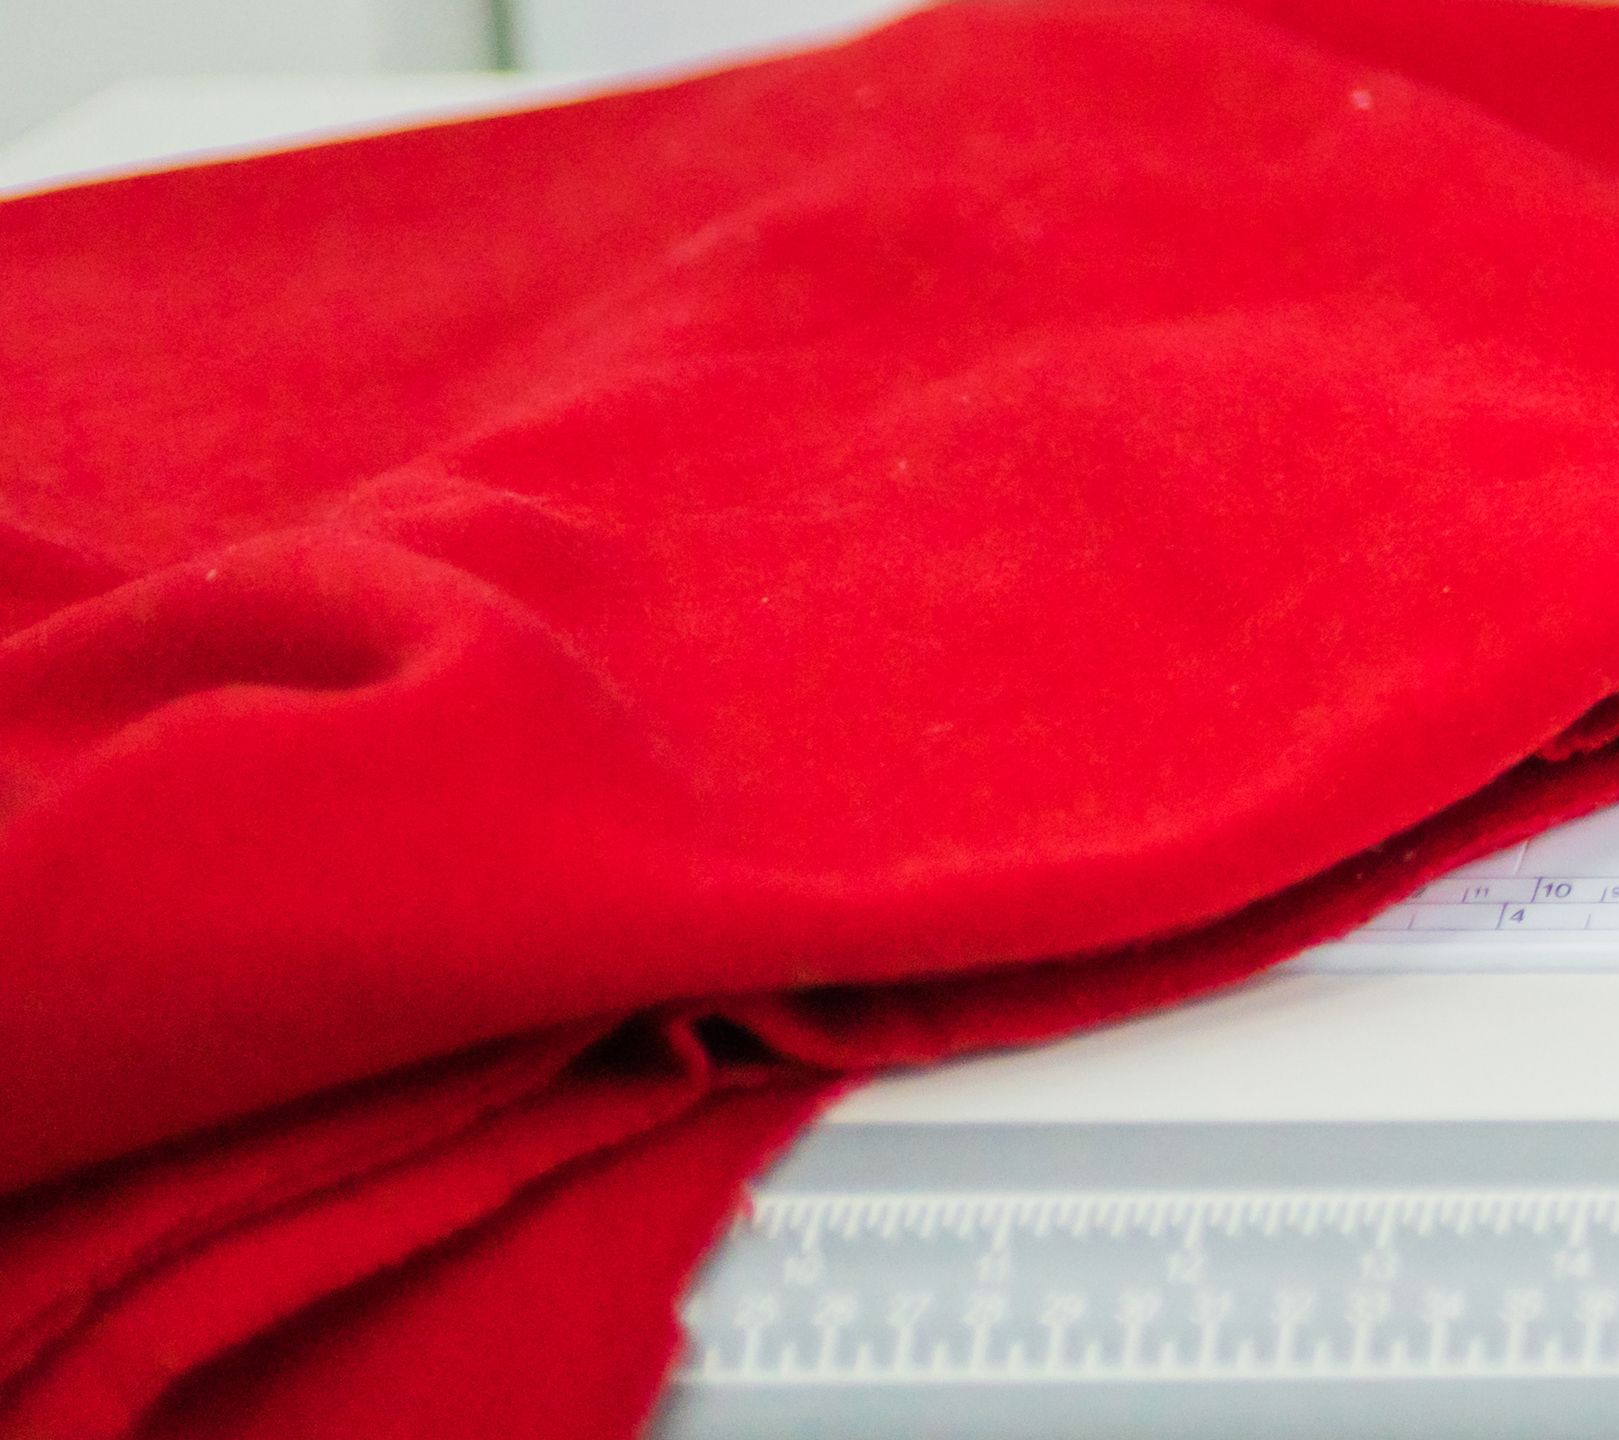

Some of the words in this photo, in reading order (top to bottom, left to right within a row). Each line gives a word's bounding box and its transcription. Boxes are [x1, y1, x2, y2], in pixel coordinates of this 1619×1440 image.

[1473, 887, 1490, 898] 11
[1544, 882, 1573, 898] 10
[1509, 908, 1525, 923] 4
